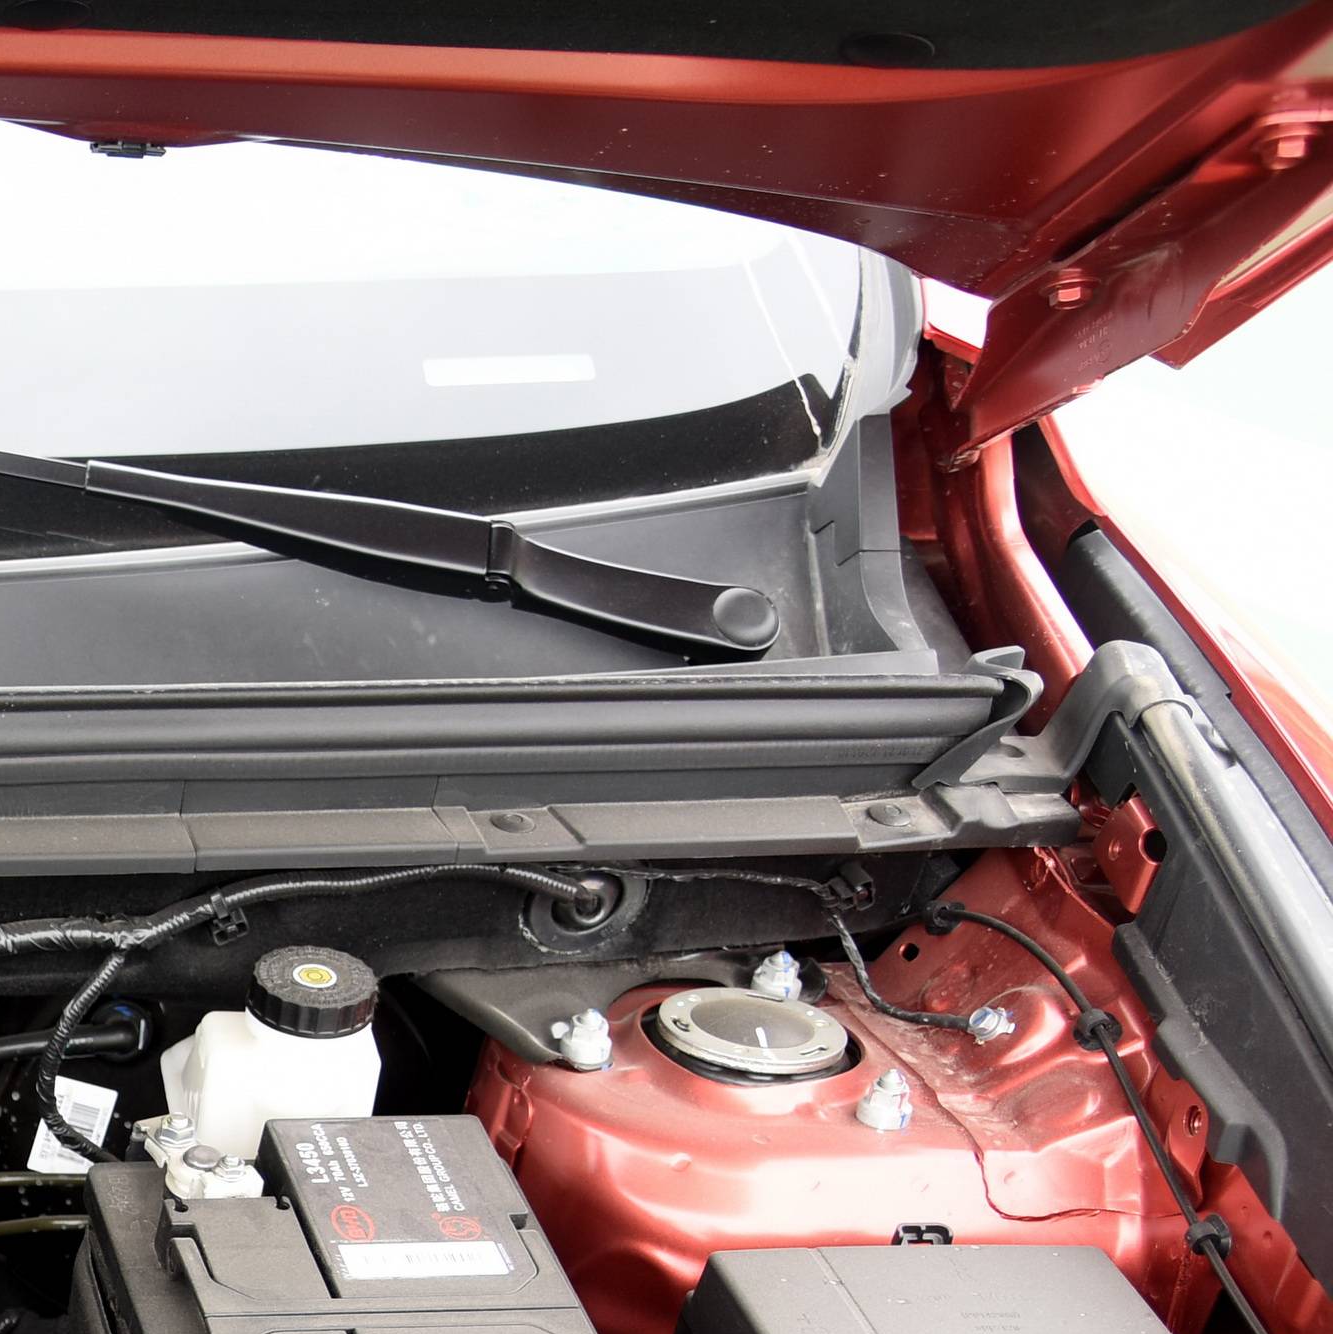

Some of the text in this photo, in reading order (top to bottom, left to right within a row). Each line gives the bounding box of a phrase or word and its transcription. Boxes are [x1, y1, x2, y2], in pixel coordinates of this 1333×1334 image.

[295, 1142, 330, 1183] L3450
[427, 1154, 451, 1182] GROUP
[338, 1186, 356, 1202] 12V
[445, 1183, 466, 1211] CAMEL
